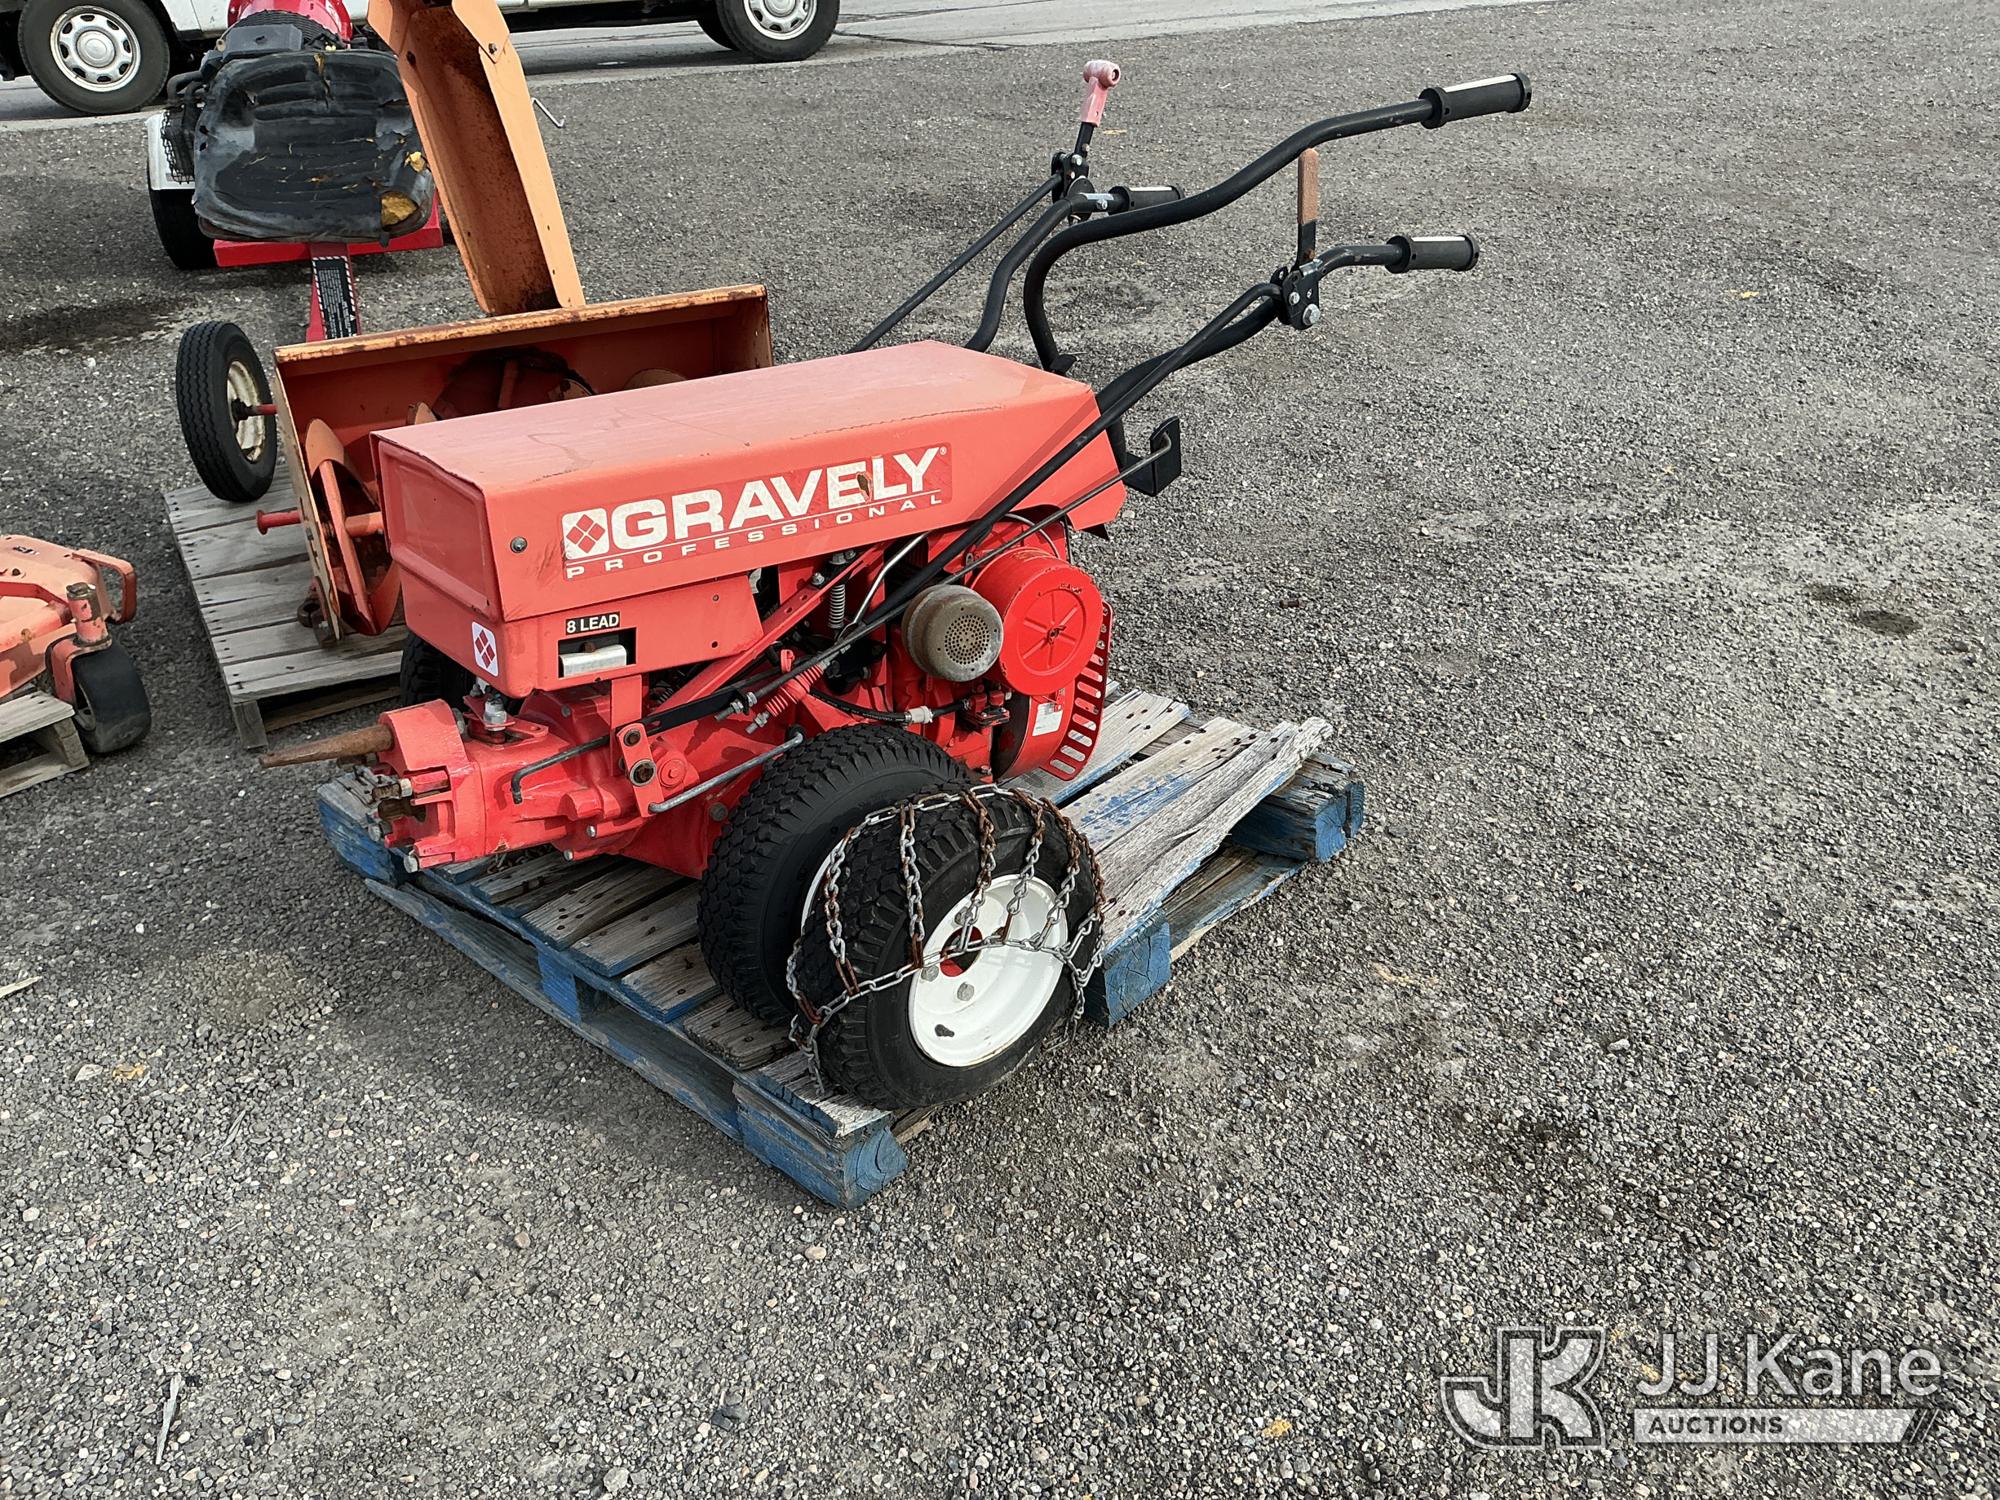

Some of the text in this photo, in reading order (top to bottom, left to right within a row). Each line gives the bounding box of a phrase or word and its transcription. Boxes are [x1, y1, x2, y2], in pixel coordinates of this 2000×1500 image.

[565, 494, 943, 579] PROFESSIONAL
[566, 613, 620, 634] 8 LEAD
